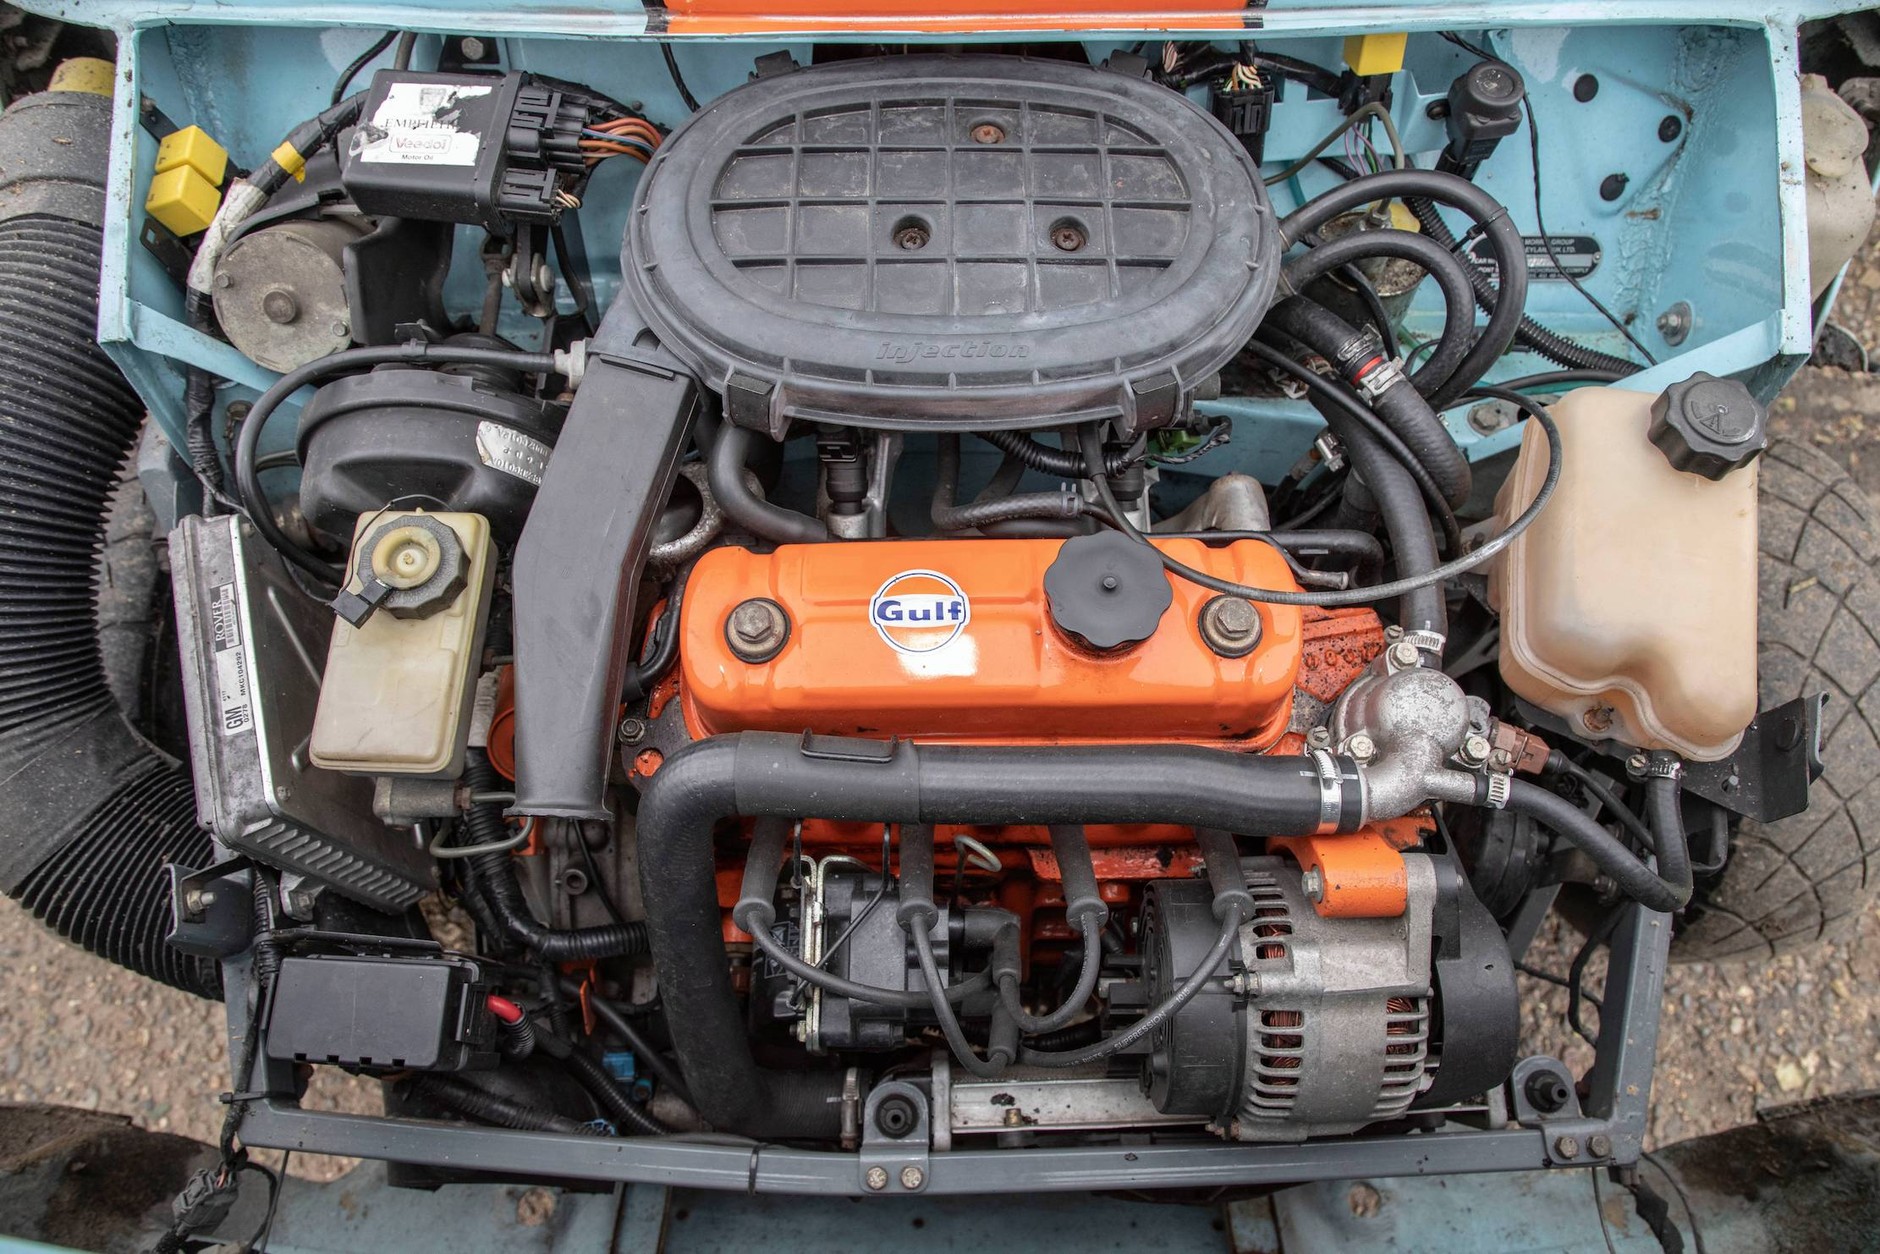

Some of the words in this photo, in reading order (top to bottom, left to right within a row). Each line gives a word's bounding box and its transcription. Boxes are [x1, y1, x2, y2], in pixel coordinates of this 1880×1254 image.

[876, 340, 1030, 364] injection
[212, 600, 226, 641] ROVER
[877, 600, 962, 621] Gulf
[235, 651, 246, 696] MKC104292
[225, 706, 243, 729] GM
[242, 703, 250, 723] 0278
[1114, 1010, 1167, 1050] SUPPRESSION
[1175, 987, 1191, 1004] 1015
